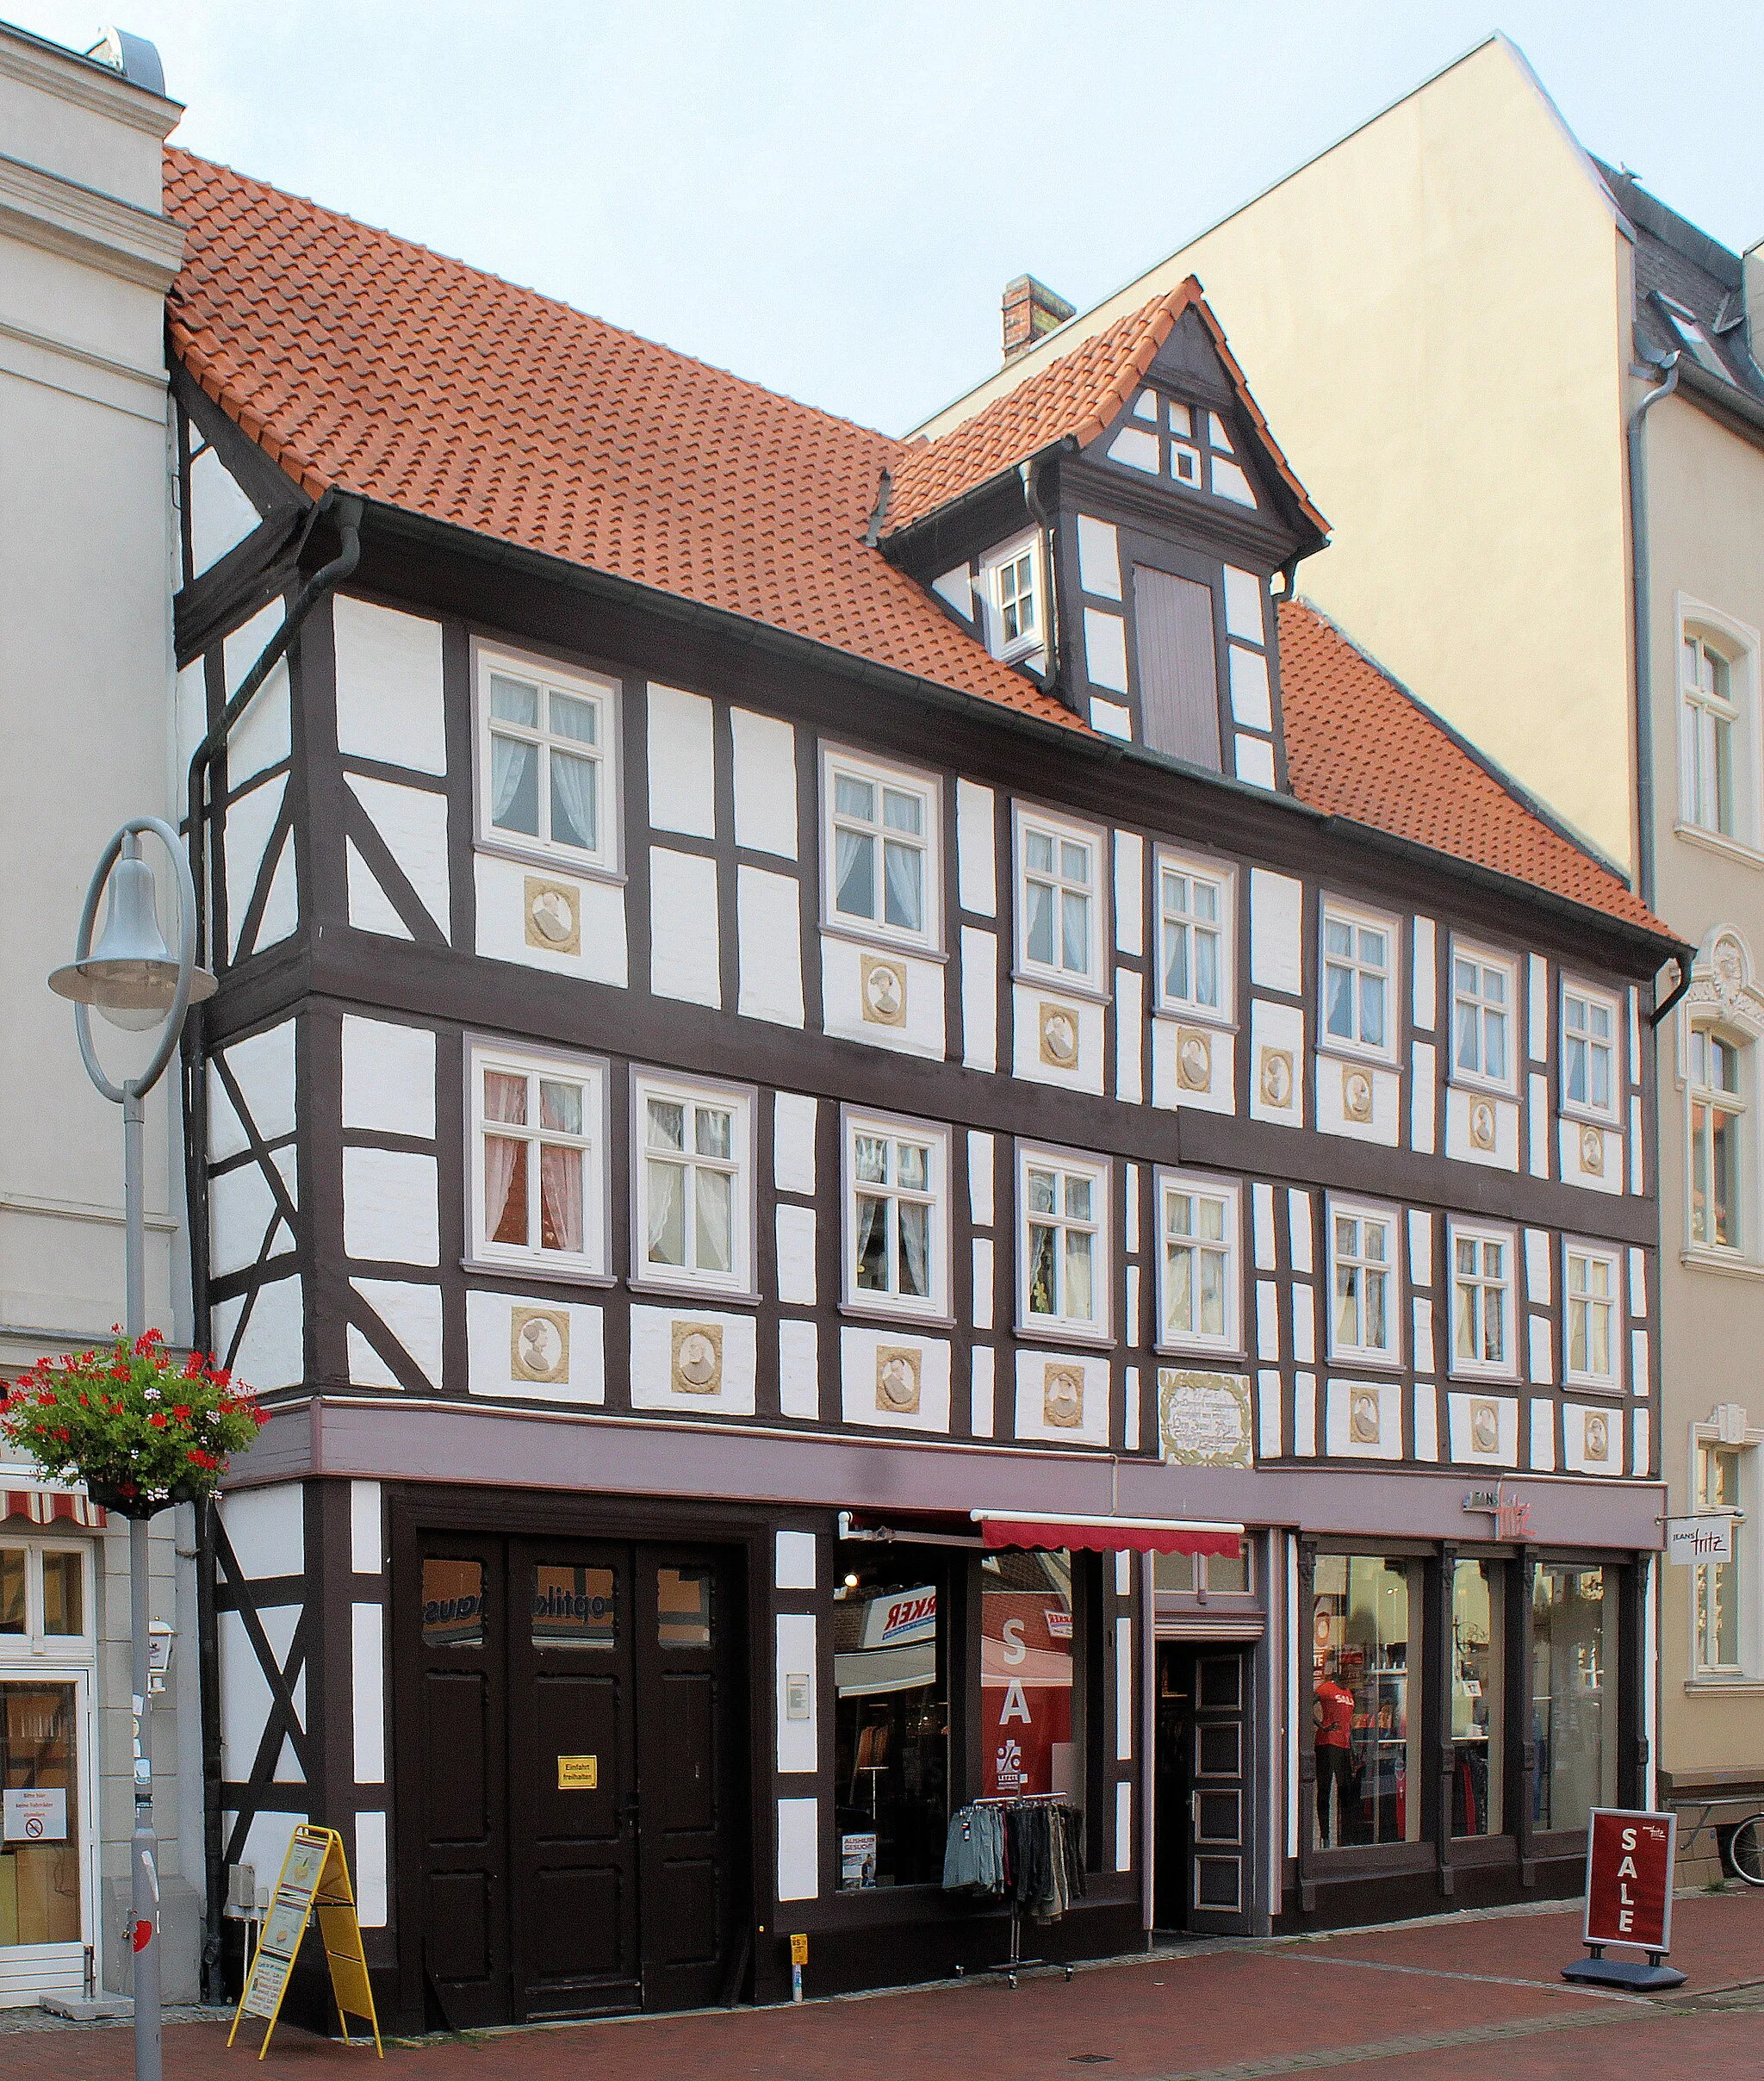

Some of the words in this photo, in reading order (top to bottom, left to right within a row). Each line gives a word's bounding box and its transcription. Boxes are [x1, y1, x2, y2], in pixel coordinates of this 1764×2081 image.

[1673, 1532, 1694, 1541] JEANS
[1691, 1528, 1727, 1556] fritz
[1617, 1828, 1637, 1933] SALE
